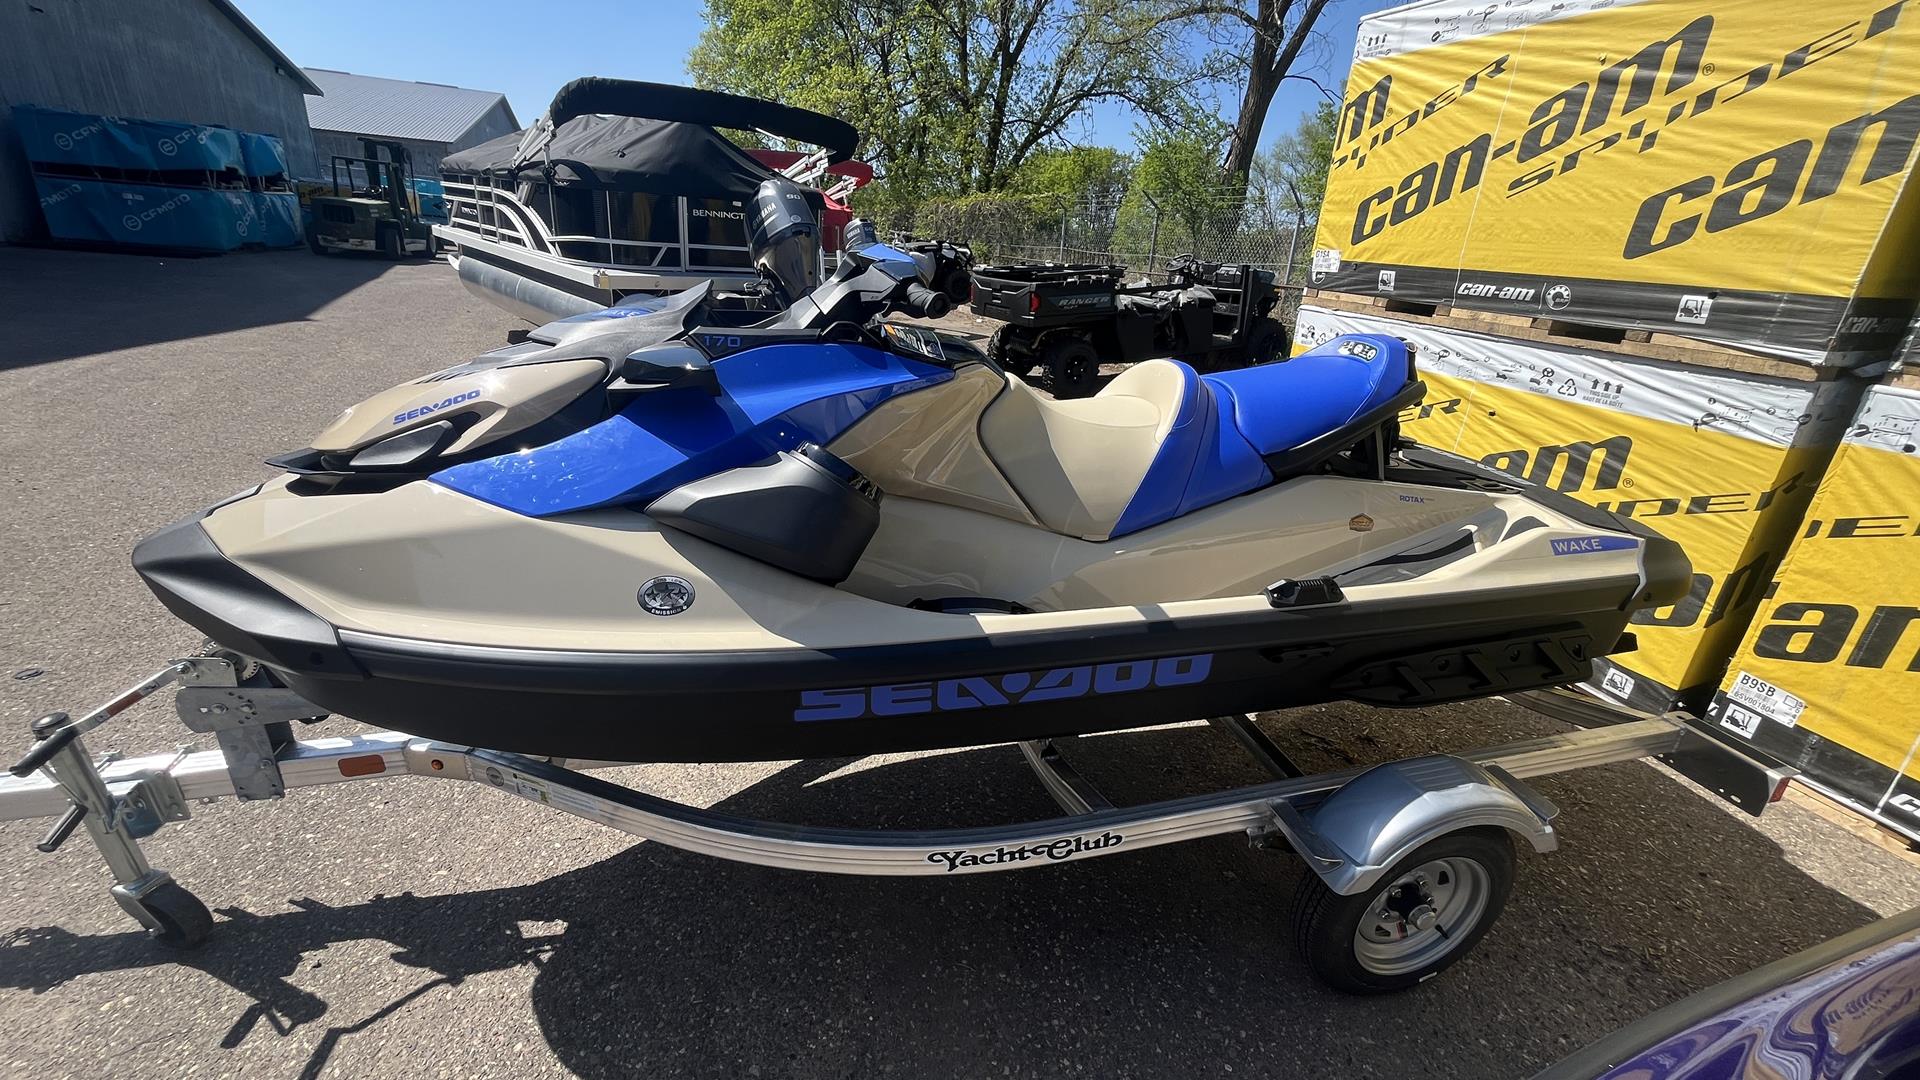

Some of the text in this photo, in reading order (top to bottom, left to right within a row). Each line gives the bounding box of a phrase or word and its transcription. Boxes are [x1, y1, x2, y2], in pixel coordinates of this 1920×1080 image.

[141, 194, 191, 221] CFMOTO
[692, 208, 746, 220] BENNINGT
[1457, 282, 1535, 302] can-am
[704, 335, 742, 348] 170
[1400, 494, 1424, 504] ROTAX
[1554, 538, 1603, 552] WAKE
[1740, 674, 1776, 697] B9SB
[927, 832, 1124, 872] Yacht Club
